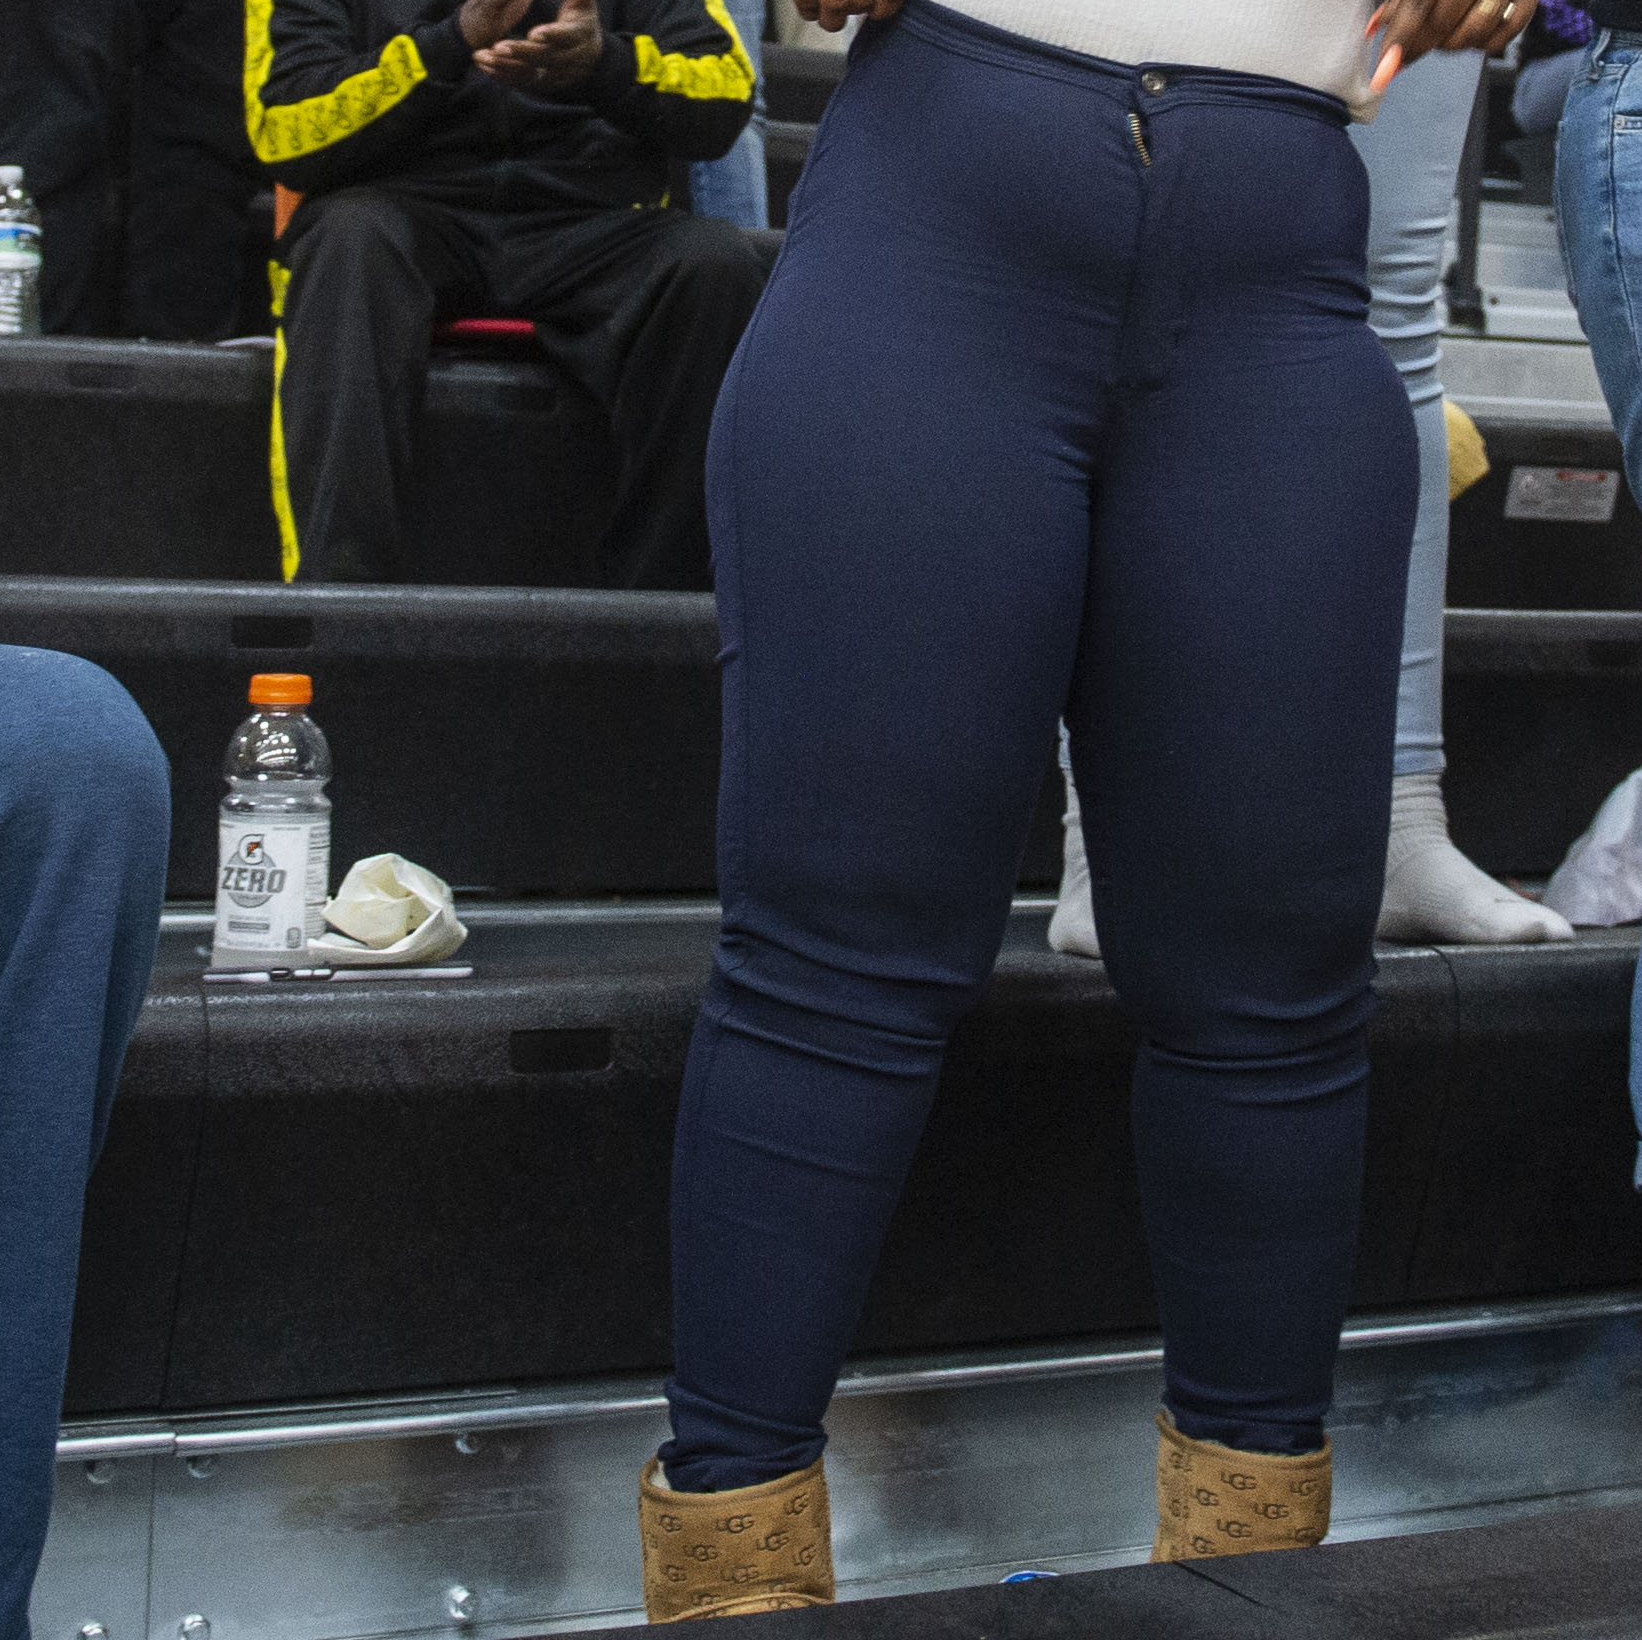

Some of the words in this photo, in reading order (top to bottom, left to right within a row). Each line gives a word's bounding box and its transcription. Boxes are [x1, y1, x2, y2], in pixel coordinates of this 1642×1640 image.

[221, 866, 288, 894] ZERO
[1220, 1471, 1257, 1491] UGG
[1255, 1503, 1290, 1520] UGG
[715, 1513, 756, 1535] UGG
